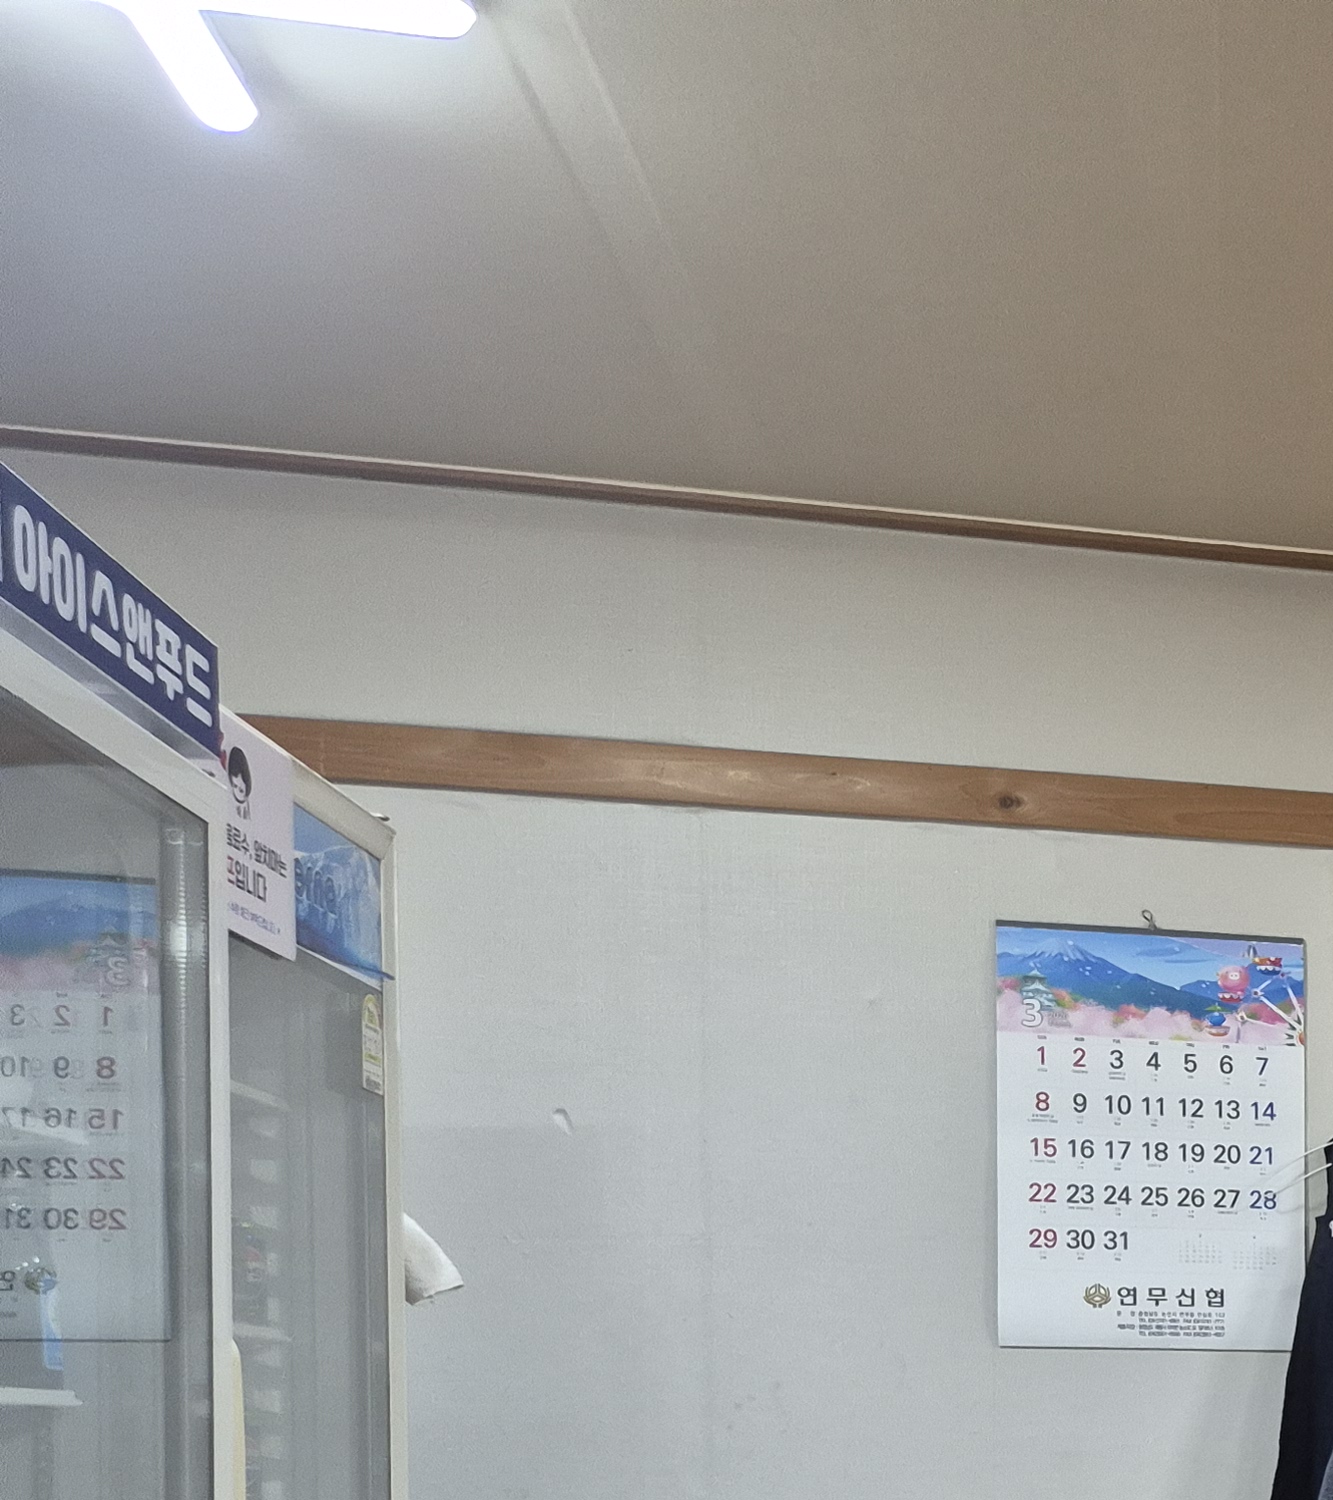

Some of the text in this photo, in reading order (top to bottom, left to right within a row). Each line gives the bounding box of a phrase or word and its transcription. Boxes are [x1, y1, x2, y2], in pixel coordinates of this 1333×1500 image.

[13, 504, 213, 727] 아이스앤푸드
[1021, 998, 1043, 1027] 3
[1037, 1045, 1269, 1076] 1 2 3 4 5 6 7
[1035, 1091, 1277, 1121] 8 9 10 11 12 13 14
[1030, 1137, 1273, 1166] 15 16 17 18 19 20 21
[1028, 1182, 1277, 1210] 22 23 24 25 26 27 28
[1028, 1228, 1128, 1251] 29 30 31
